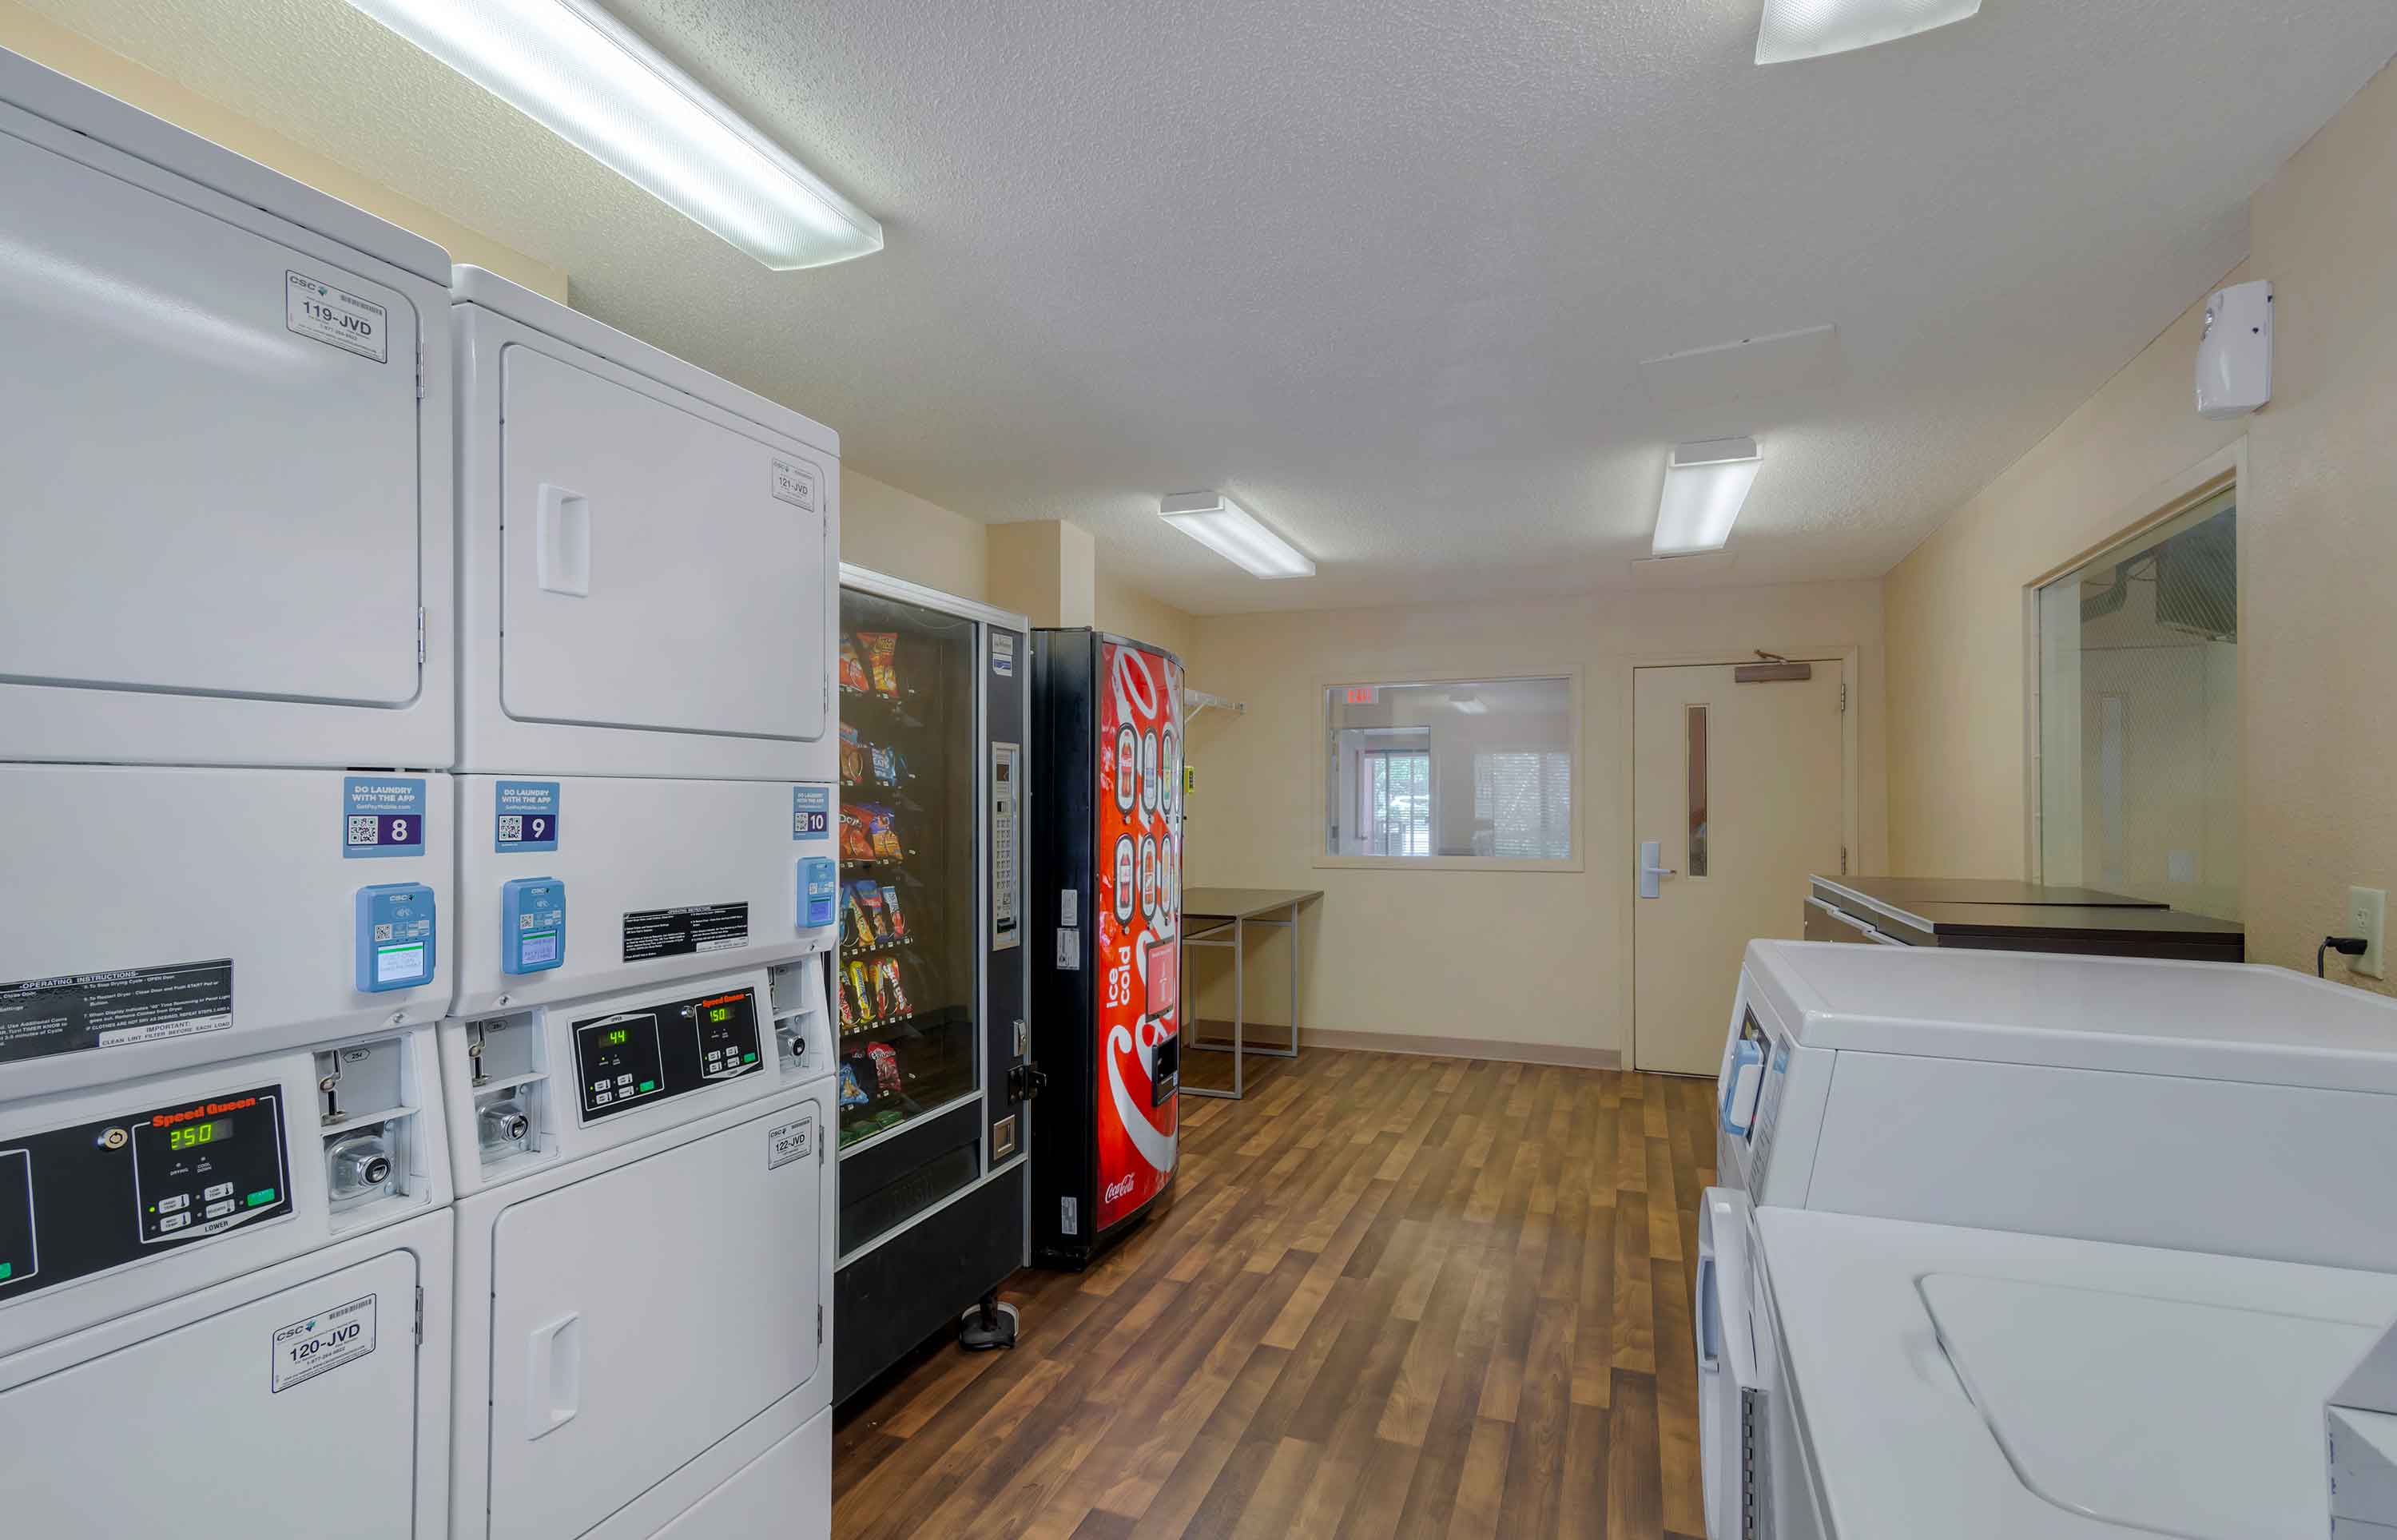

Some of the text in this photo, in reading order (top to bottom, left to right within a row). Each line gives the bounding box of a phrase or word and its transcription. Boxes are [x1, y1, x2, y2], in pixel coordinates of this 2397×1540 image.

[289, 276, 316, 291] CSC
[304, 301, 372, 335] 119-JVD
[780, 477, 808, 494] 121-JVD
[392, 820, 407, 841] 8
[532, 818, 545, 839] 9
[811, 815, 824, 830] 10
[1118, 946, 1131, 1006] cold
[610, 1030, 624, 1044] 44
[153, 1097, 256, 1128] Speed Queen
[171, 1124, 212, 1149] 250
[776, 1134, 805, 1152] 122-JVD
[205, 1220, 229, 1232] LOWER
[277, 1326, 304, 1341] CSC
[290, 1324, 360, 1361] 120-JVD
